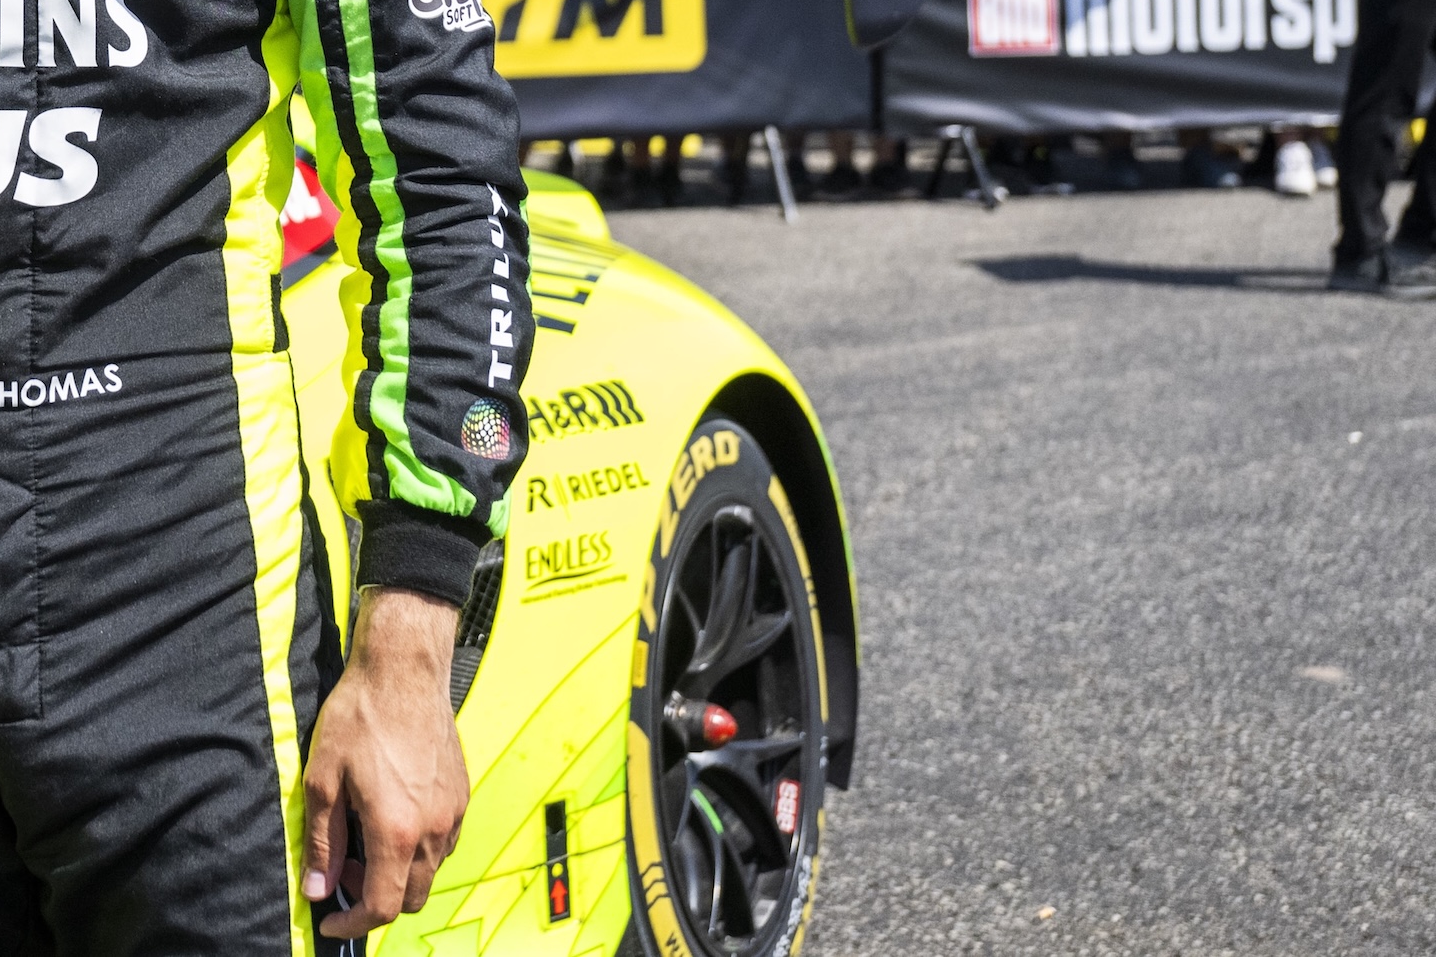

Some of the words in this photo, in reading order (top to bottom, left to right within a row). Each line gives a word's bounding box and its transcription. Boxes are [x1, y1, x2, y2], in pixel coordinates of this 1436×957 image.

[446, 3, 473, 26] SOFT
[487, 182, 514, 388] TRILUX
[567, 461, 650, 502] RIEDEL
[525, 530, 612, 580] ENDLESS
